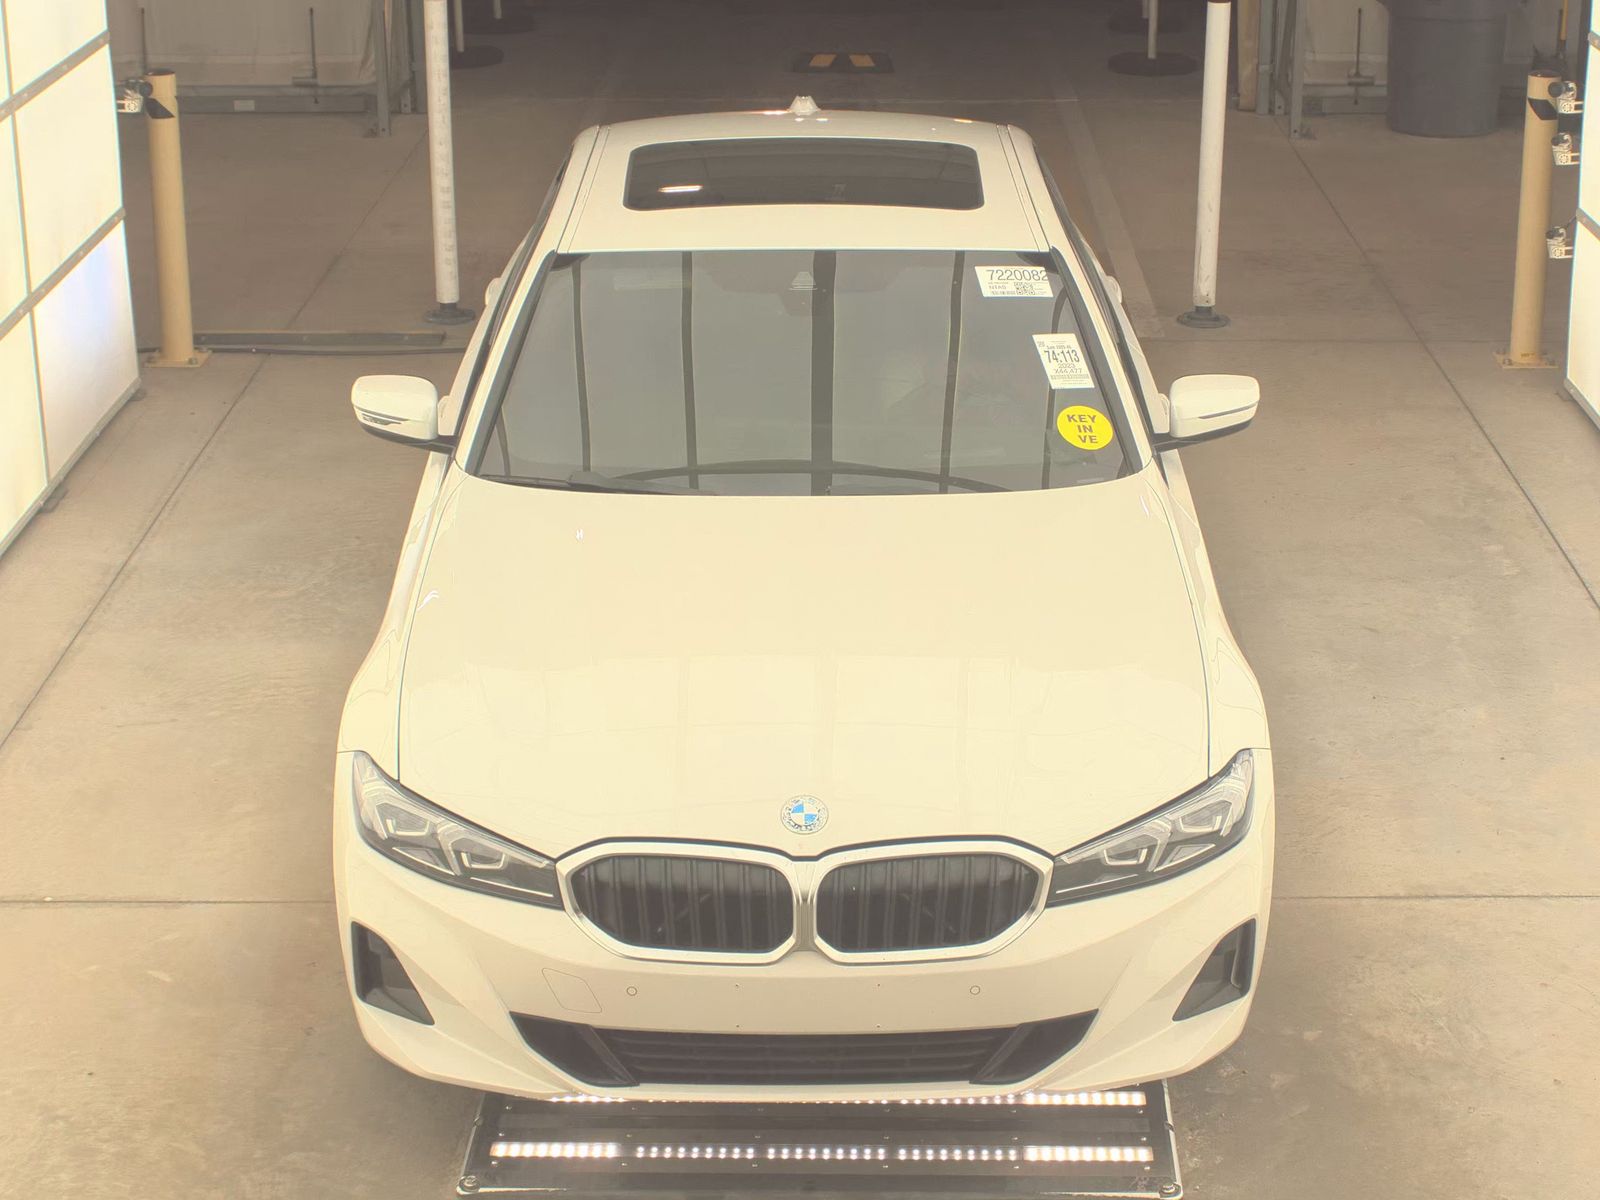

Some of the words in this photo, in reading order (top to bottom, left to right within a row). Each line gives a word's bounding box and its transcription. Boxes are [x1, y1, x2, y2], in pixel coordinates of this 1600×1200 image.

[986, 269, 1048, 281] 7220082
[1044, 350, 1080, 363] 74:113
[1067, 414, 1097, 423] KEY
[1077, 425, 1093, 433] IN
[1078, 435, 1098, 443] VE
